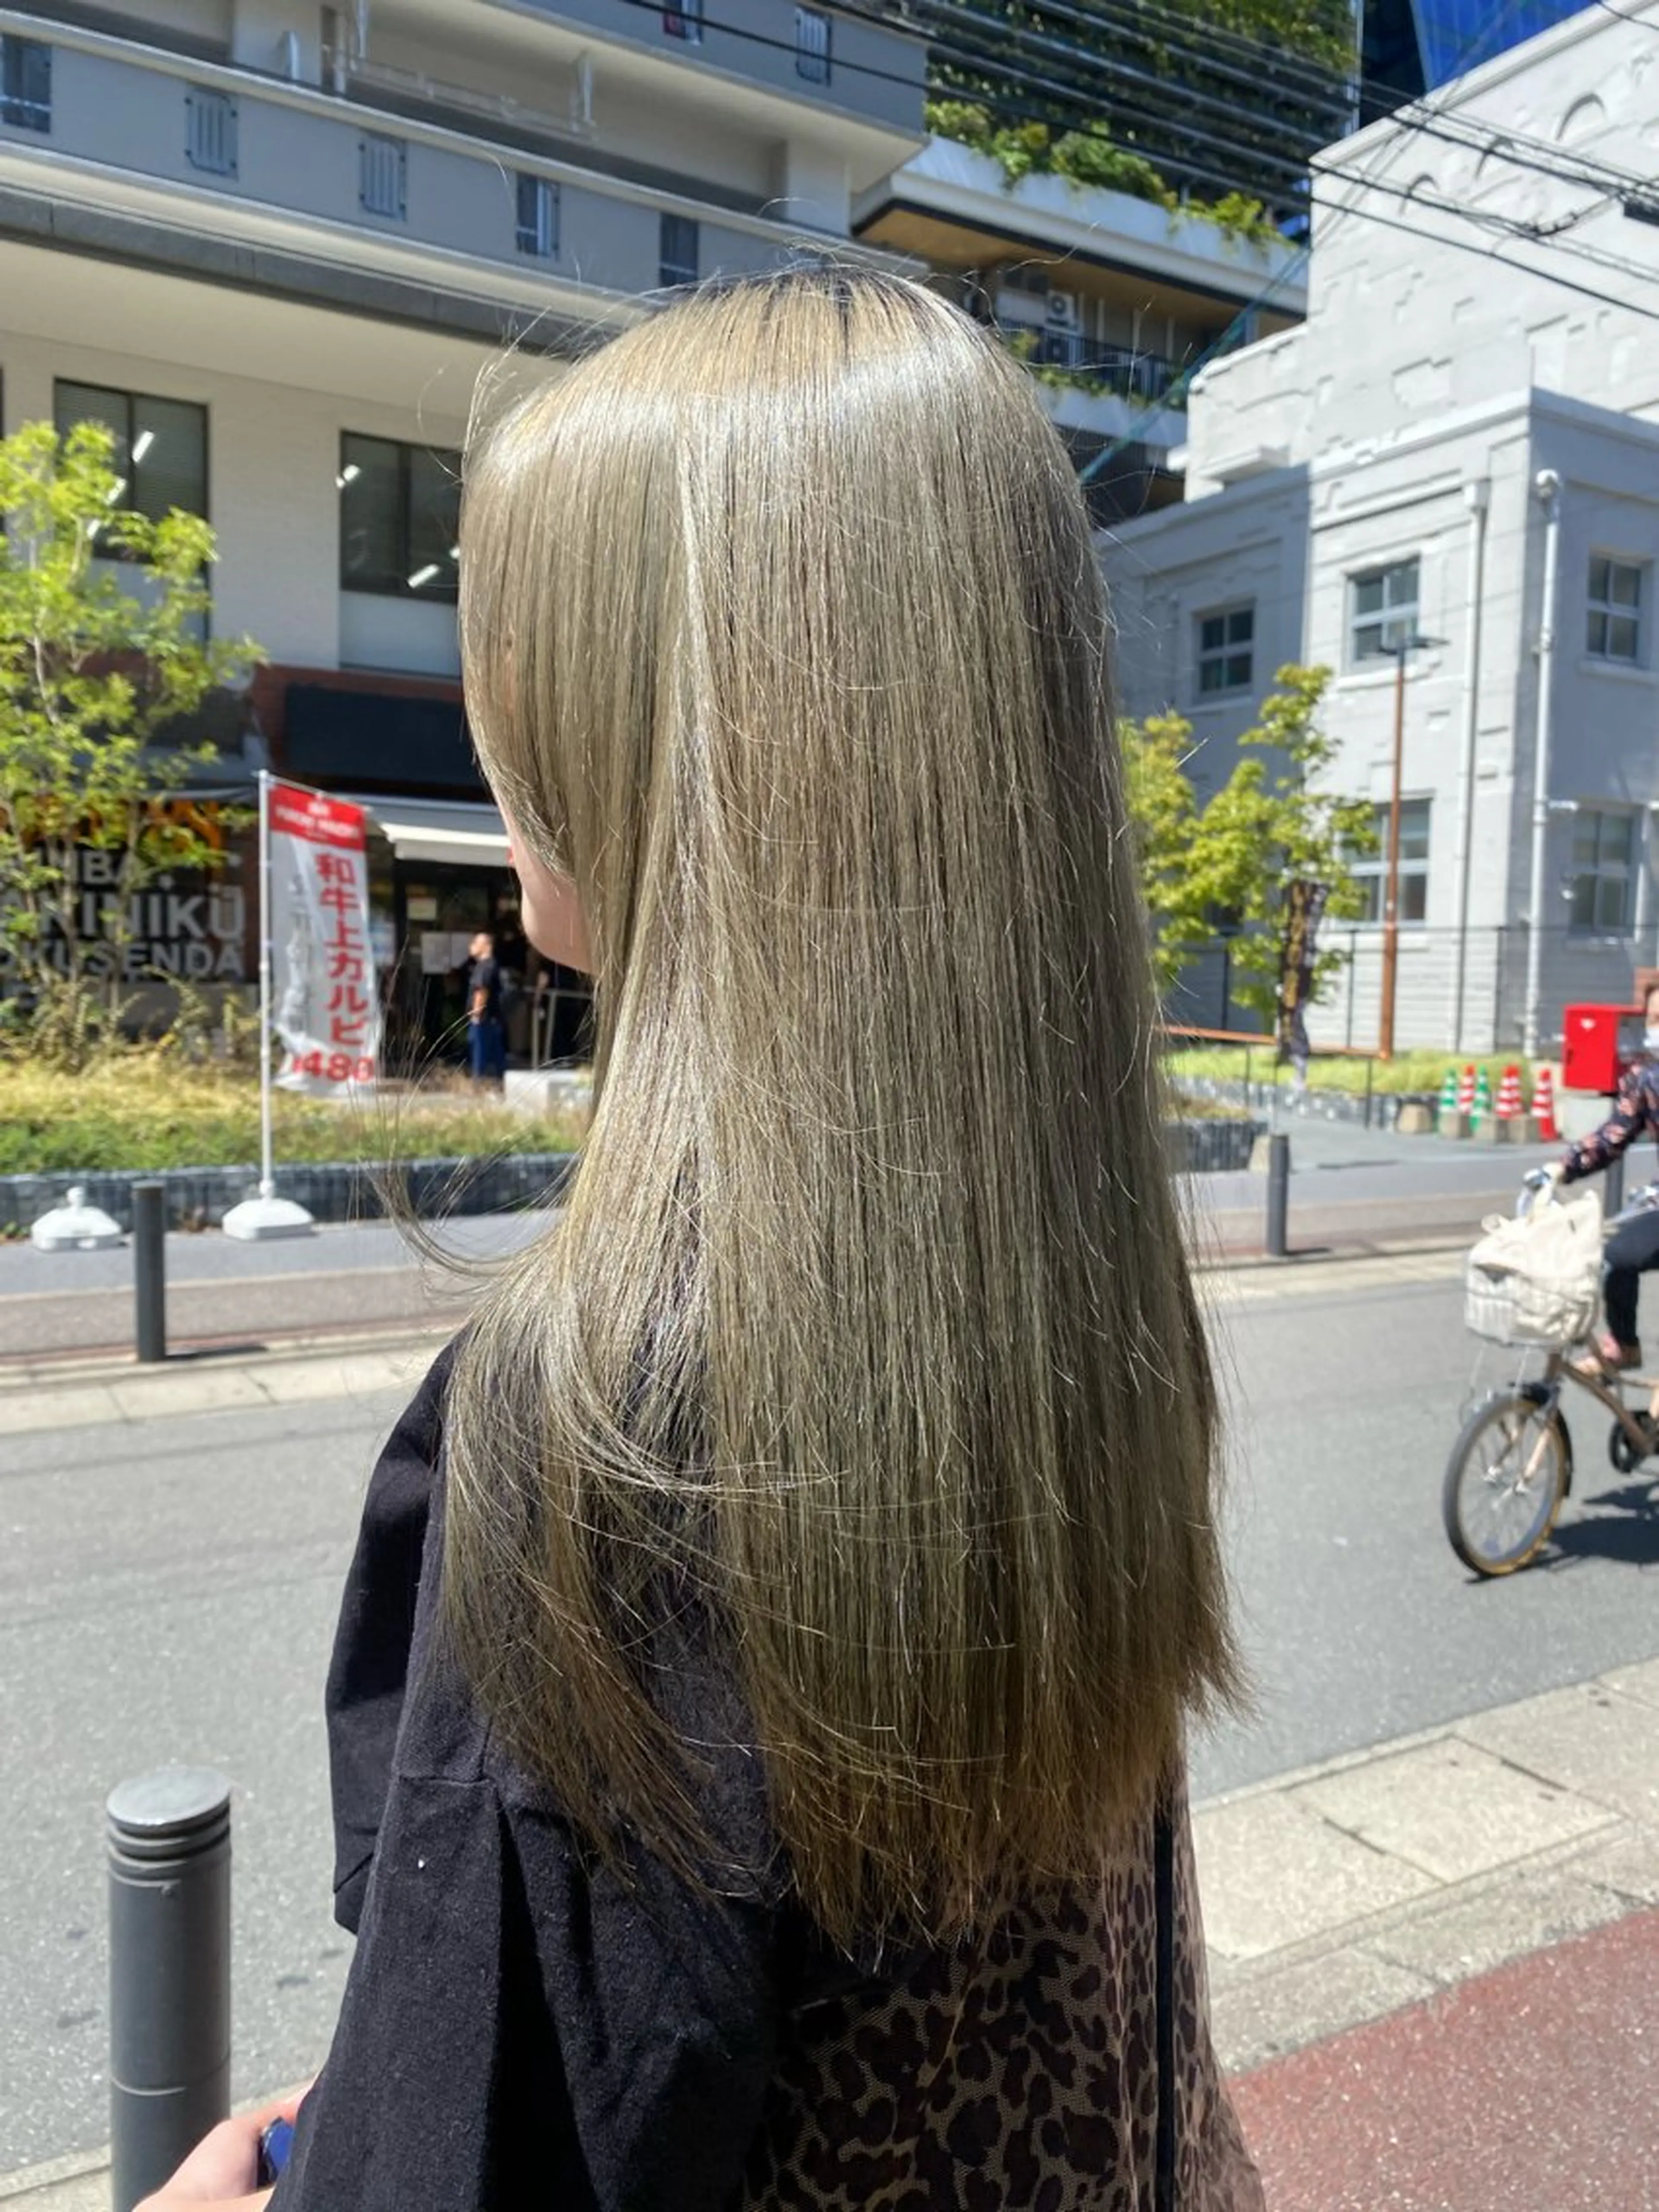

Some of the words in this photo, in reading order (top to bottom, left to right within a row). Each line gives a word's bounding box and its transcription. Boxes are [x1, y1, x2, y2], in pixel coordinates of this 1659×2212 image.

[316, 853, 369, 1046] 和牛上カルビ
